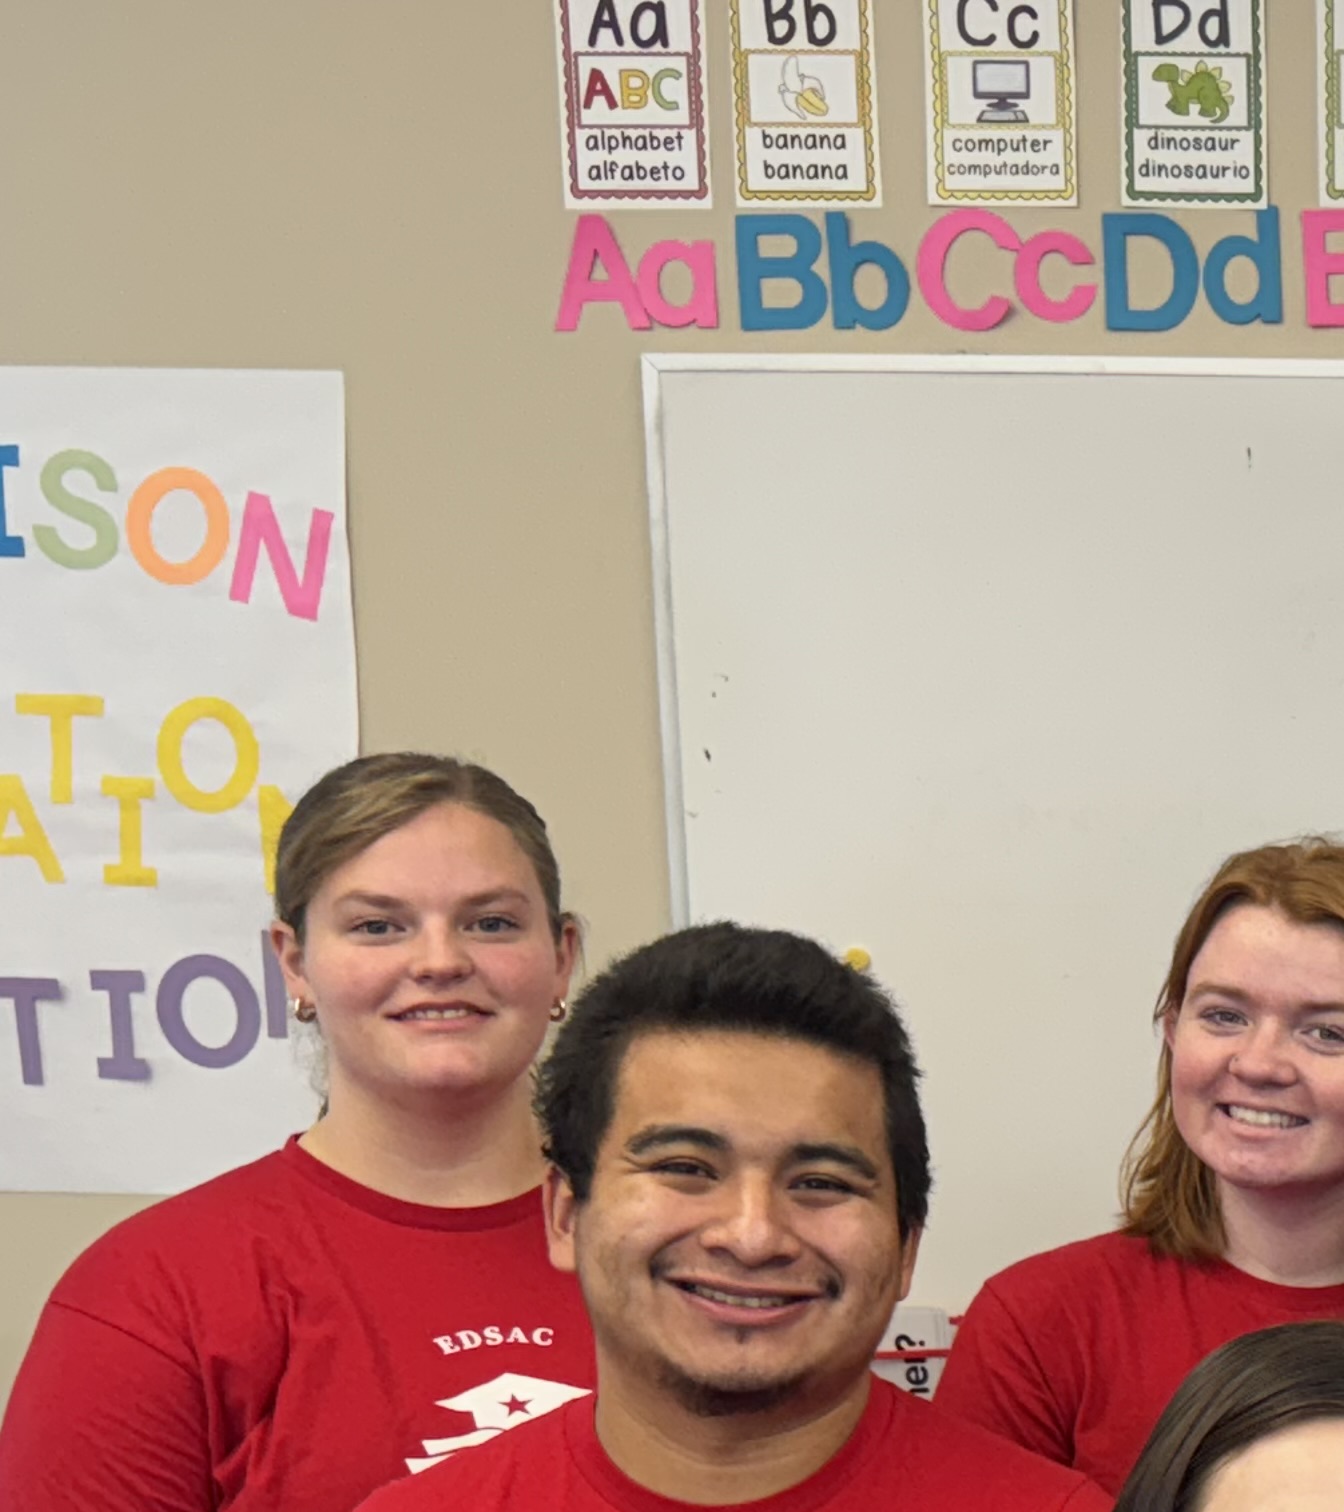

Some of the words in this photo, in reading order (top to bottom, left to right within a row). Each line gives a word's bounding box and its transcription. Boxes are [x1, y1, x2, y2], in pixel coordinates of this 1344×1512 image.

[588, 0, 669, 49] Aa
[763, 0, 837, 47] Bb
[957, 0, 1039, 49] Cc
[1152, 0, 1230, 48] Dd
[583, 67, 683, 112] ABC
[585, 129, 684, 154] alphabet
[762, 129, 846, 150] banana
[952, 135, 1052, 156] computer
[1148, 131, 1240, 151] dinosaur
[588, 160, 685, 181] alfabeto
[763, 160, 848, 180] banana
[946, 161, 1059, 179] computadora
[1137, 160, 1250, 180] dinosaurio
[557, 215, 717, 330] Aa
[737, 213, 907, 329] Bb
[918, 209, 1095, 330] Cc
[1104, 208, 1280, 330] Dd
[433, 1326, 553, 1355] EDSAC
